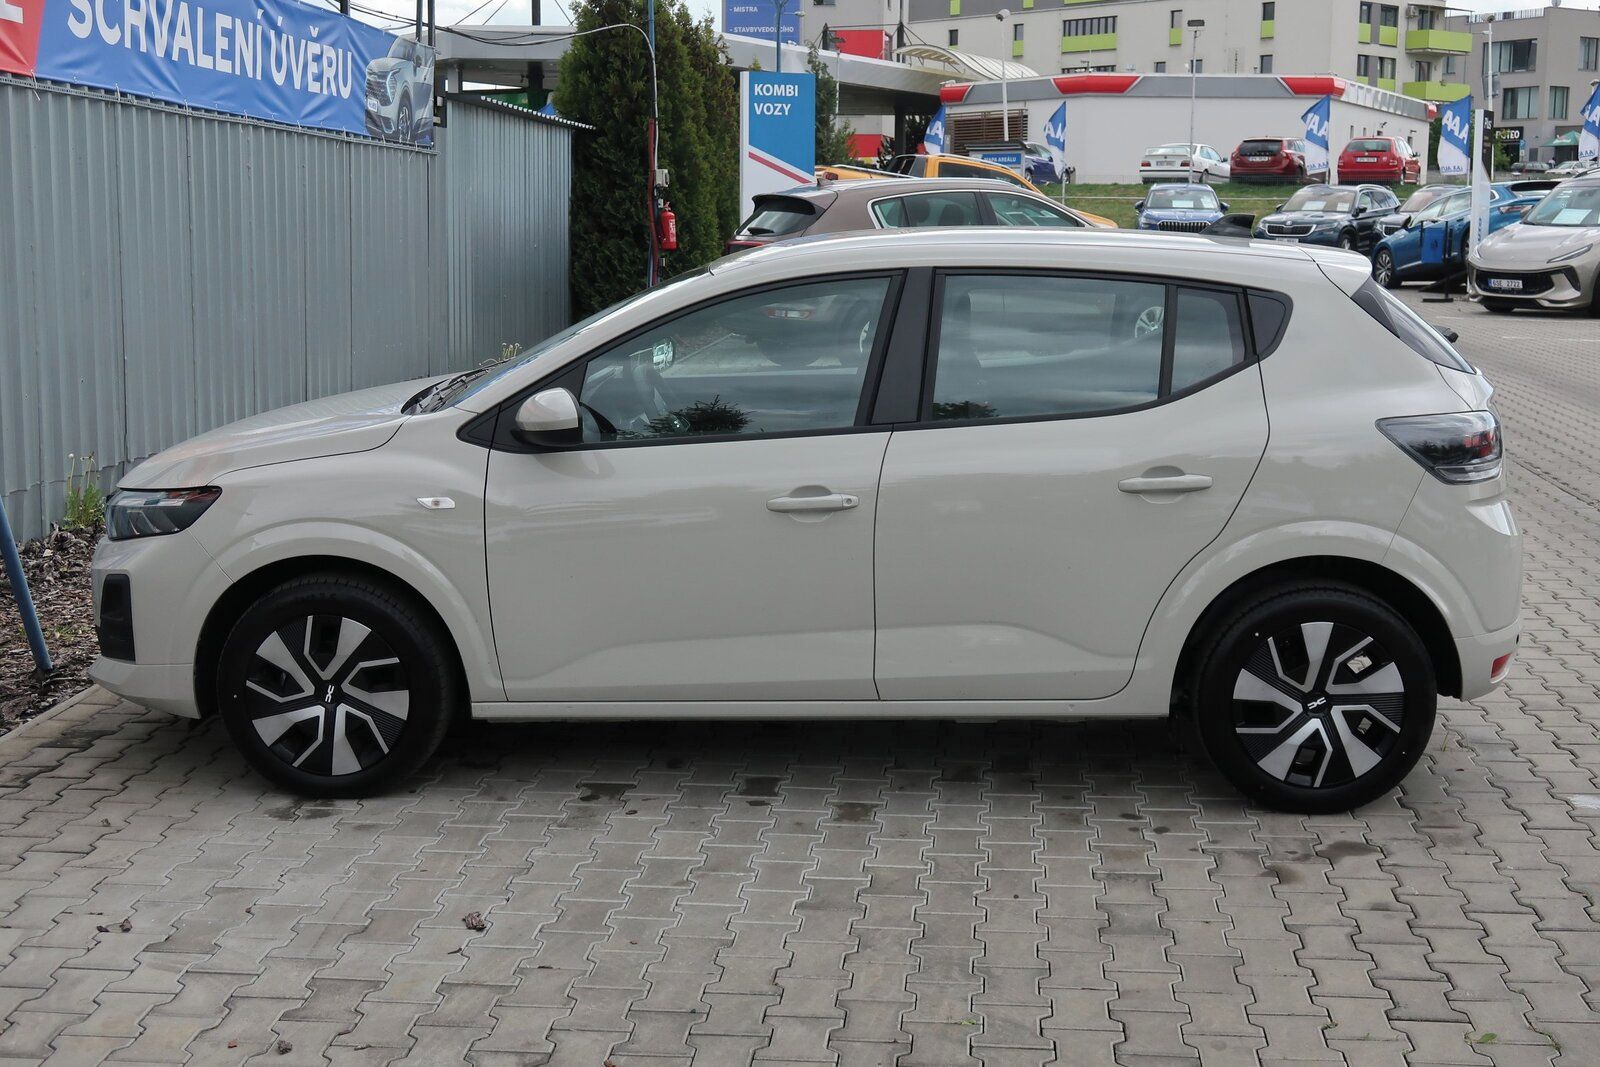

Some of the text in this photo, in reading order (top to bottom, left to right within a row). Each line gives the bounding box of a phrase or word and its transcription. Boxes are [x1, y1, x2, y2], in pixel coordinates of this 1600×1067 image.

[68, 0, 352, 100] SCHVALENÍ ÚVĚRU
[754, 83, 799, 97] KOMBI
[754, 103, 791, 116] VOZY
[1442, 109, 1469, 144] AAA
